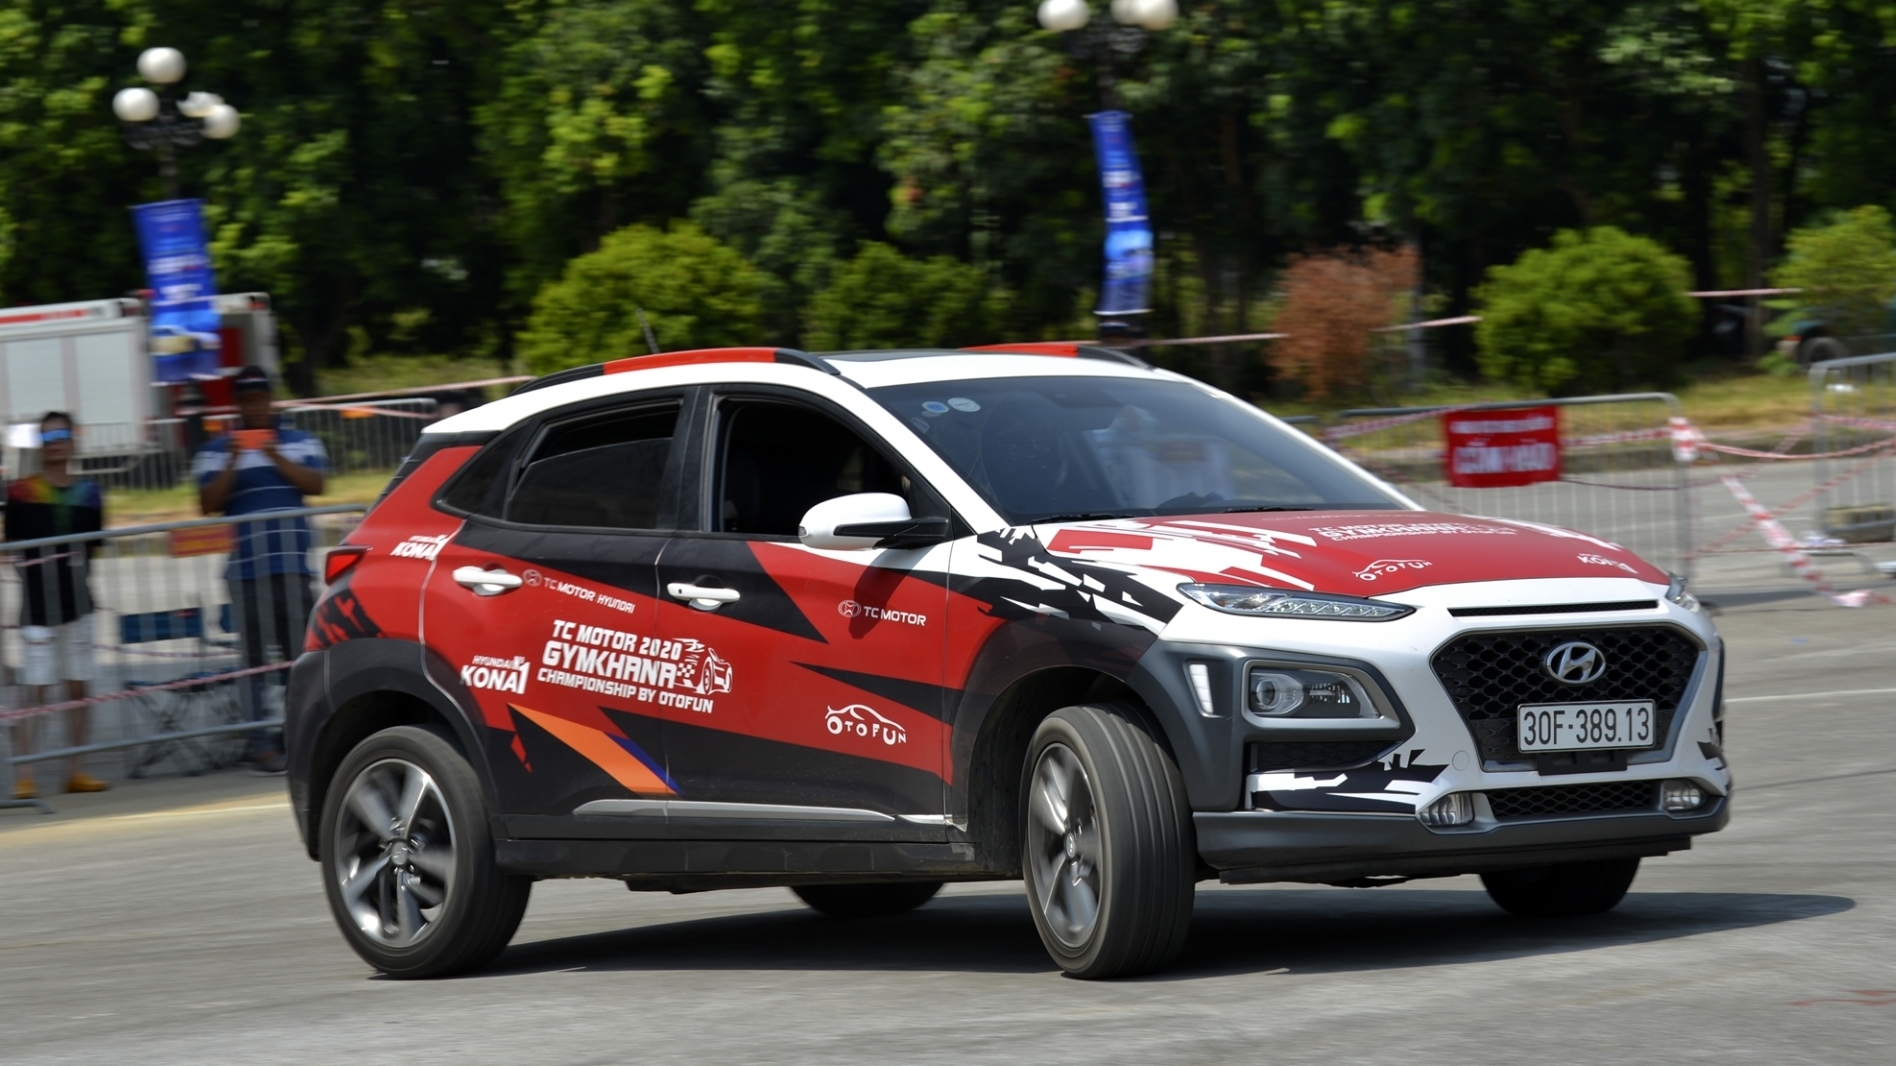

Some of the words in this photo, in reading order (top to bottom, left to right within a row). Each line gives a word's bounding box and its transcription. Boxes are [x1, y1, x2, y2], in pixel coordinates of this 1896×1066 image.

[543, 577, 557, 590] TC
[556, 581, 597, 601] MOTOR
[597, 593, 636, 614] HYUNDAI
[863, 605, 880, 619] TC
[880, 608, 927, 626] MOTOR
[552, 619, 576, 640] TC
[576, 624, 638, 652] MOTOR
[639, 636, 683, 661] 2020
[542, 640, 678, 689] GYMKHANA
[536, 667, 637, 699] CHAMPIONSHIP
[637, 687, 657, 703] BY
[658, 690, 714, 714] OTOFUN
[826, 714, 907, 746] OTOFUN
[1523, 706, 1650, 746] 30F-389.13
